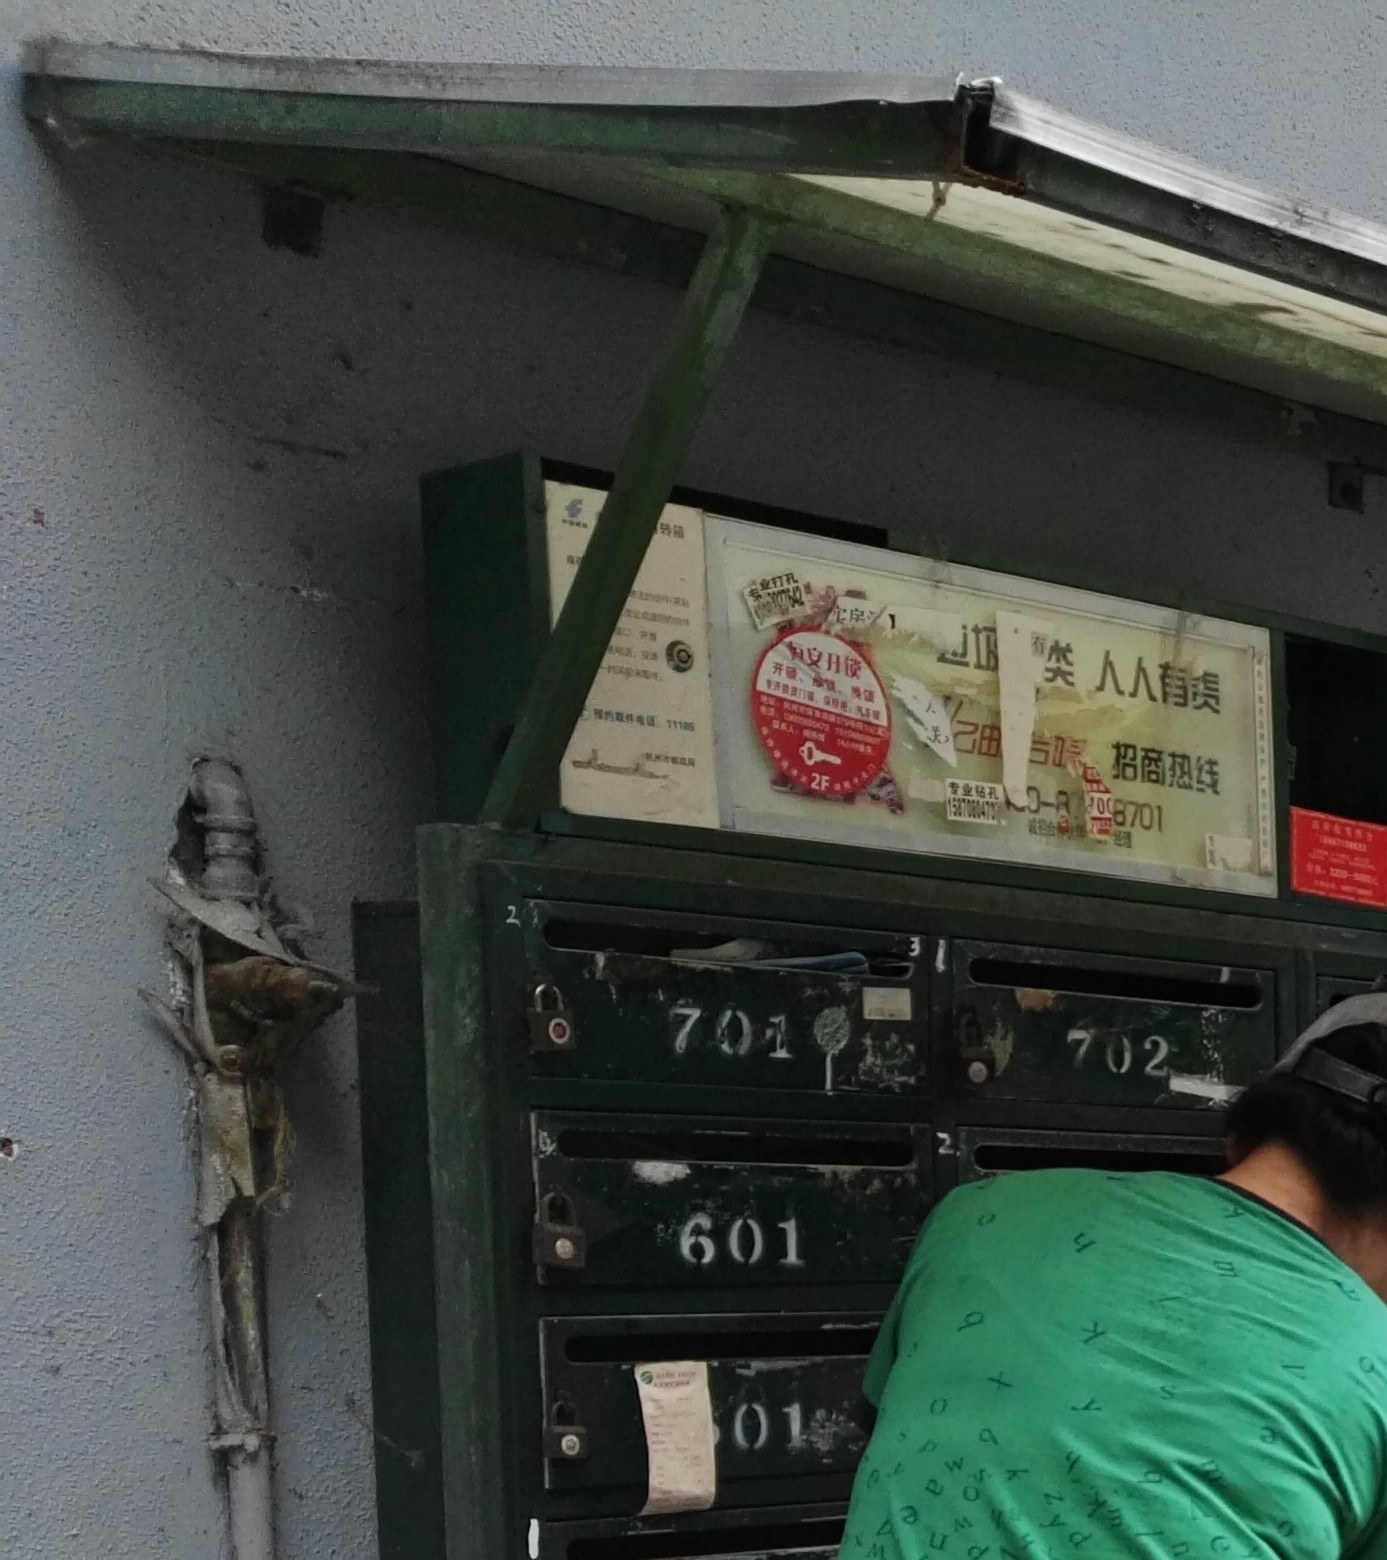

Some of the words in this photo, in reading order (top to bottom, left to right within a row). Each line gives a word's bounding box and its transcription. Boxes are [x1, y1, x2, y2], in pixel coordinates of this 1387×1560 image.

[1094, 650, 1222, 714] 人人有责
[810, 773, 830, 790] 2F
[948, 781, 999, 800] 专业钻孔
[1111, 741, 1221, 796] 招商热线
[671, 1007, 793, 1060] 701
[1066, 1028, 1169, 1076] 702
[679, 1212, 806, 1266] 601
